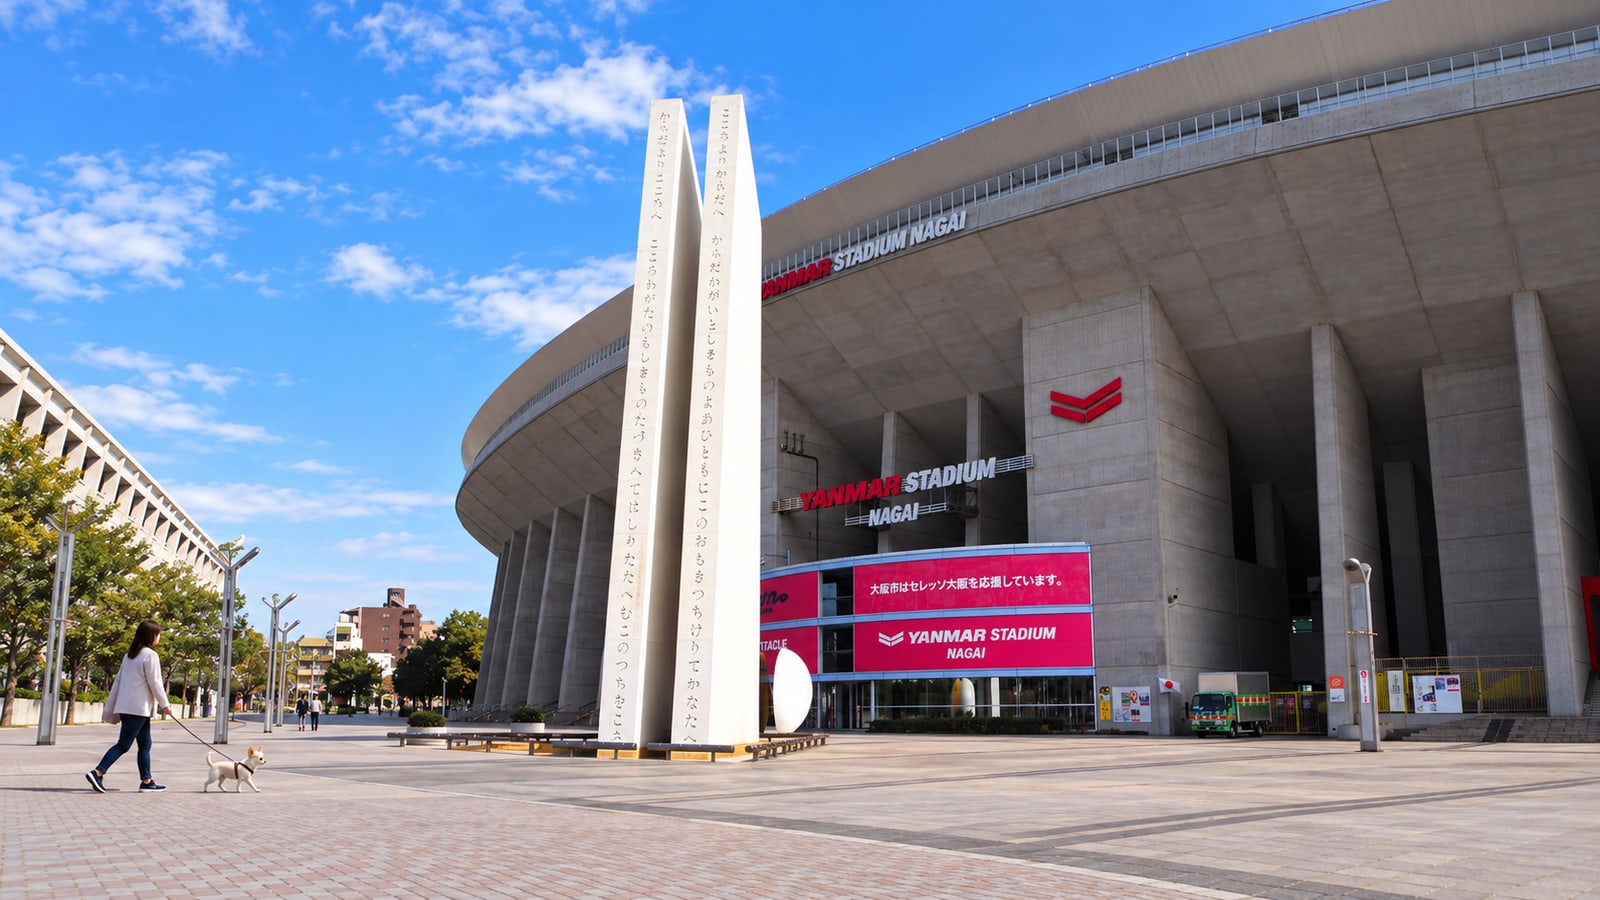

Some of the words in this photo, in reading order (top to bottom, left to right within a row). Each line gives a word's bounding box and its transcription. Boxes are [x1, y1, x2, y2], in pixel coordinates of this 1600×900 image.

[833, 229, 908, 273] STADIUM
[909, 210, 967, 247] NAGAI
[799, 474, 902, 512] YANMAR
[903, 457, 997, 494] STADIUM
[868, 502, 920, 528] NAGAI
[869, 574, 1063, 596] 大阪市はセレッソ大阪を応援しています。
[908, 628, 987, 645] YANMAR
[990, 626, 1057, 642] STADIUM
[946, 647, 986, 660] NAGAI
